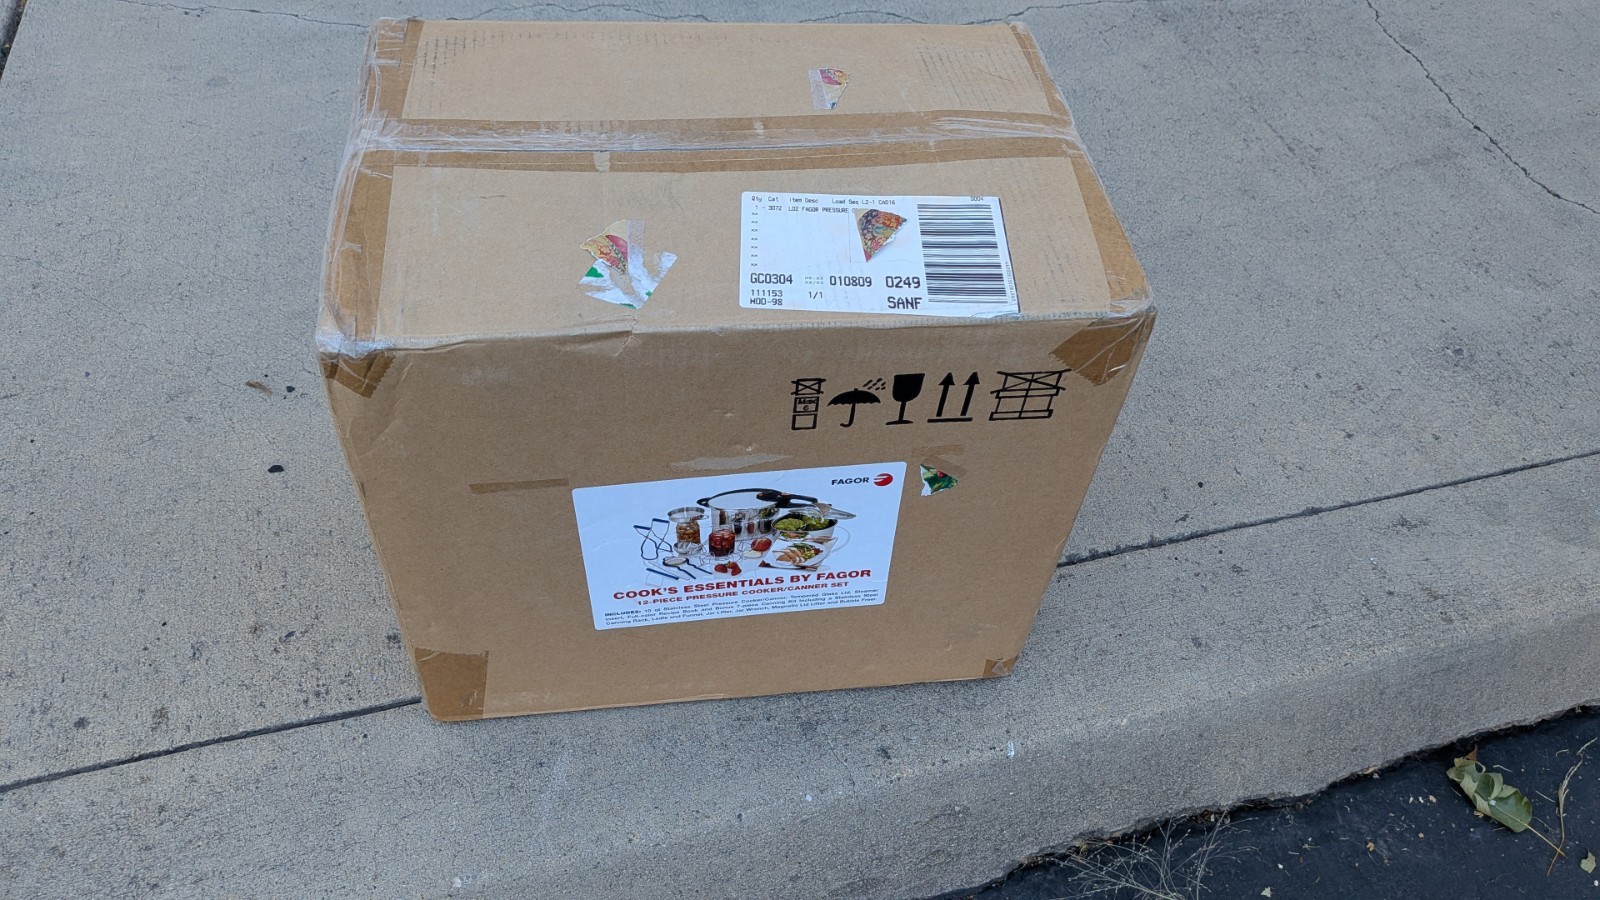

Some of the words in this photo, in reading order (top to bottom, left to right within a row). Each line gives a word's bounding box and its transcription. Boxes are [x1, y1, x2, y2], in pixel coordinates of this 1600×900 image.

[829, 275, 872, 287] 010809
[885, 276, 921, 289] 0249
[751, 289, 783, 297] 111153
[808, 291, 823, 299] 1/1
[887, 296, 922, 309] SANF
[831, 477, 869, 486] FAGOR
[613, 587, 678, 600] COOK'S
[683, 576, 784, 593] ESSENTIALS
[790, 574, 812, 583] BY
[817, 570, 871, 581] FAGOR
[637, 596, 682, 606] 12-PIECE
[686, 591, 738, 601] PRESSURE
[741, 583, 828, 596] COOKER/CANNER
